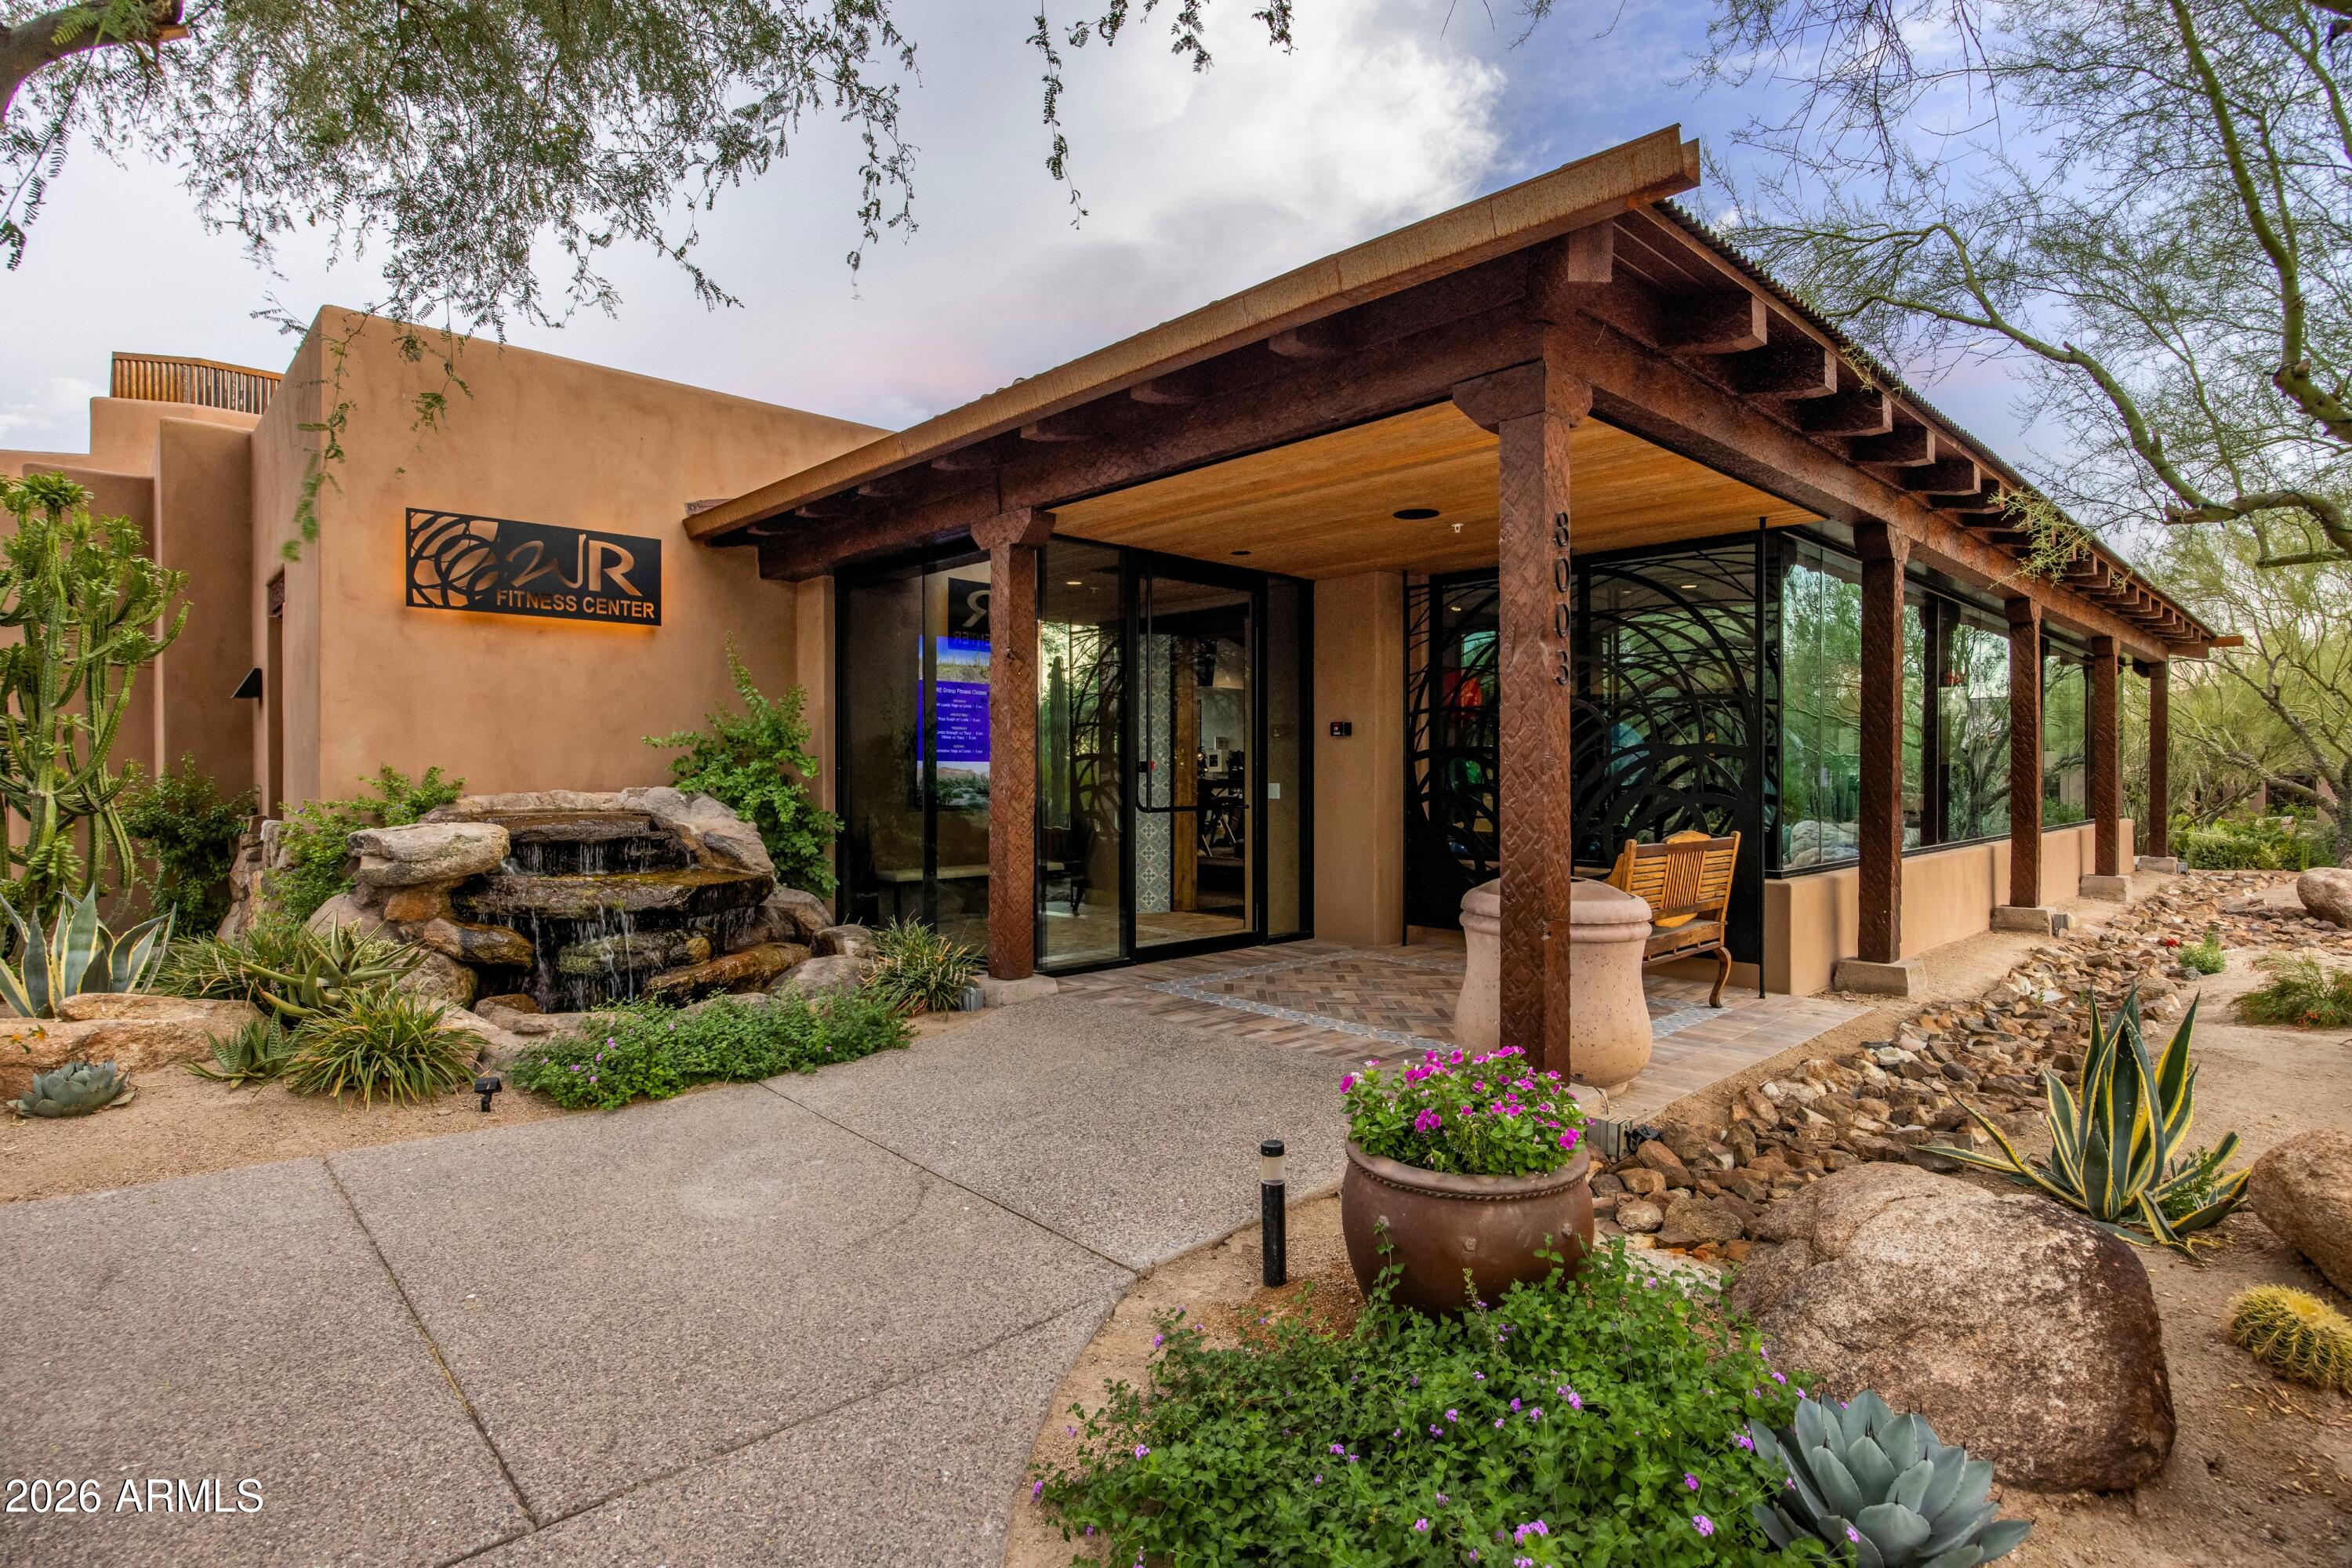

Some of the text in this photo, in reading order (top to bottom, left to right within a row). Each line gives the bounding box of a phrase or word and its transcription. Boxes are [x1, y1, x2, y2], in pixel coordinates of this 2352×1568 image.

[496, 589, 655, 619] FITNESS CENTER
[1555, 510, 1570, 686] 8003
